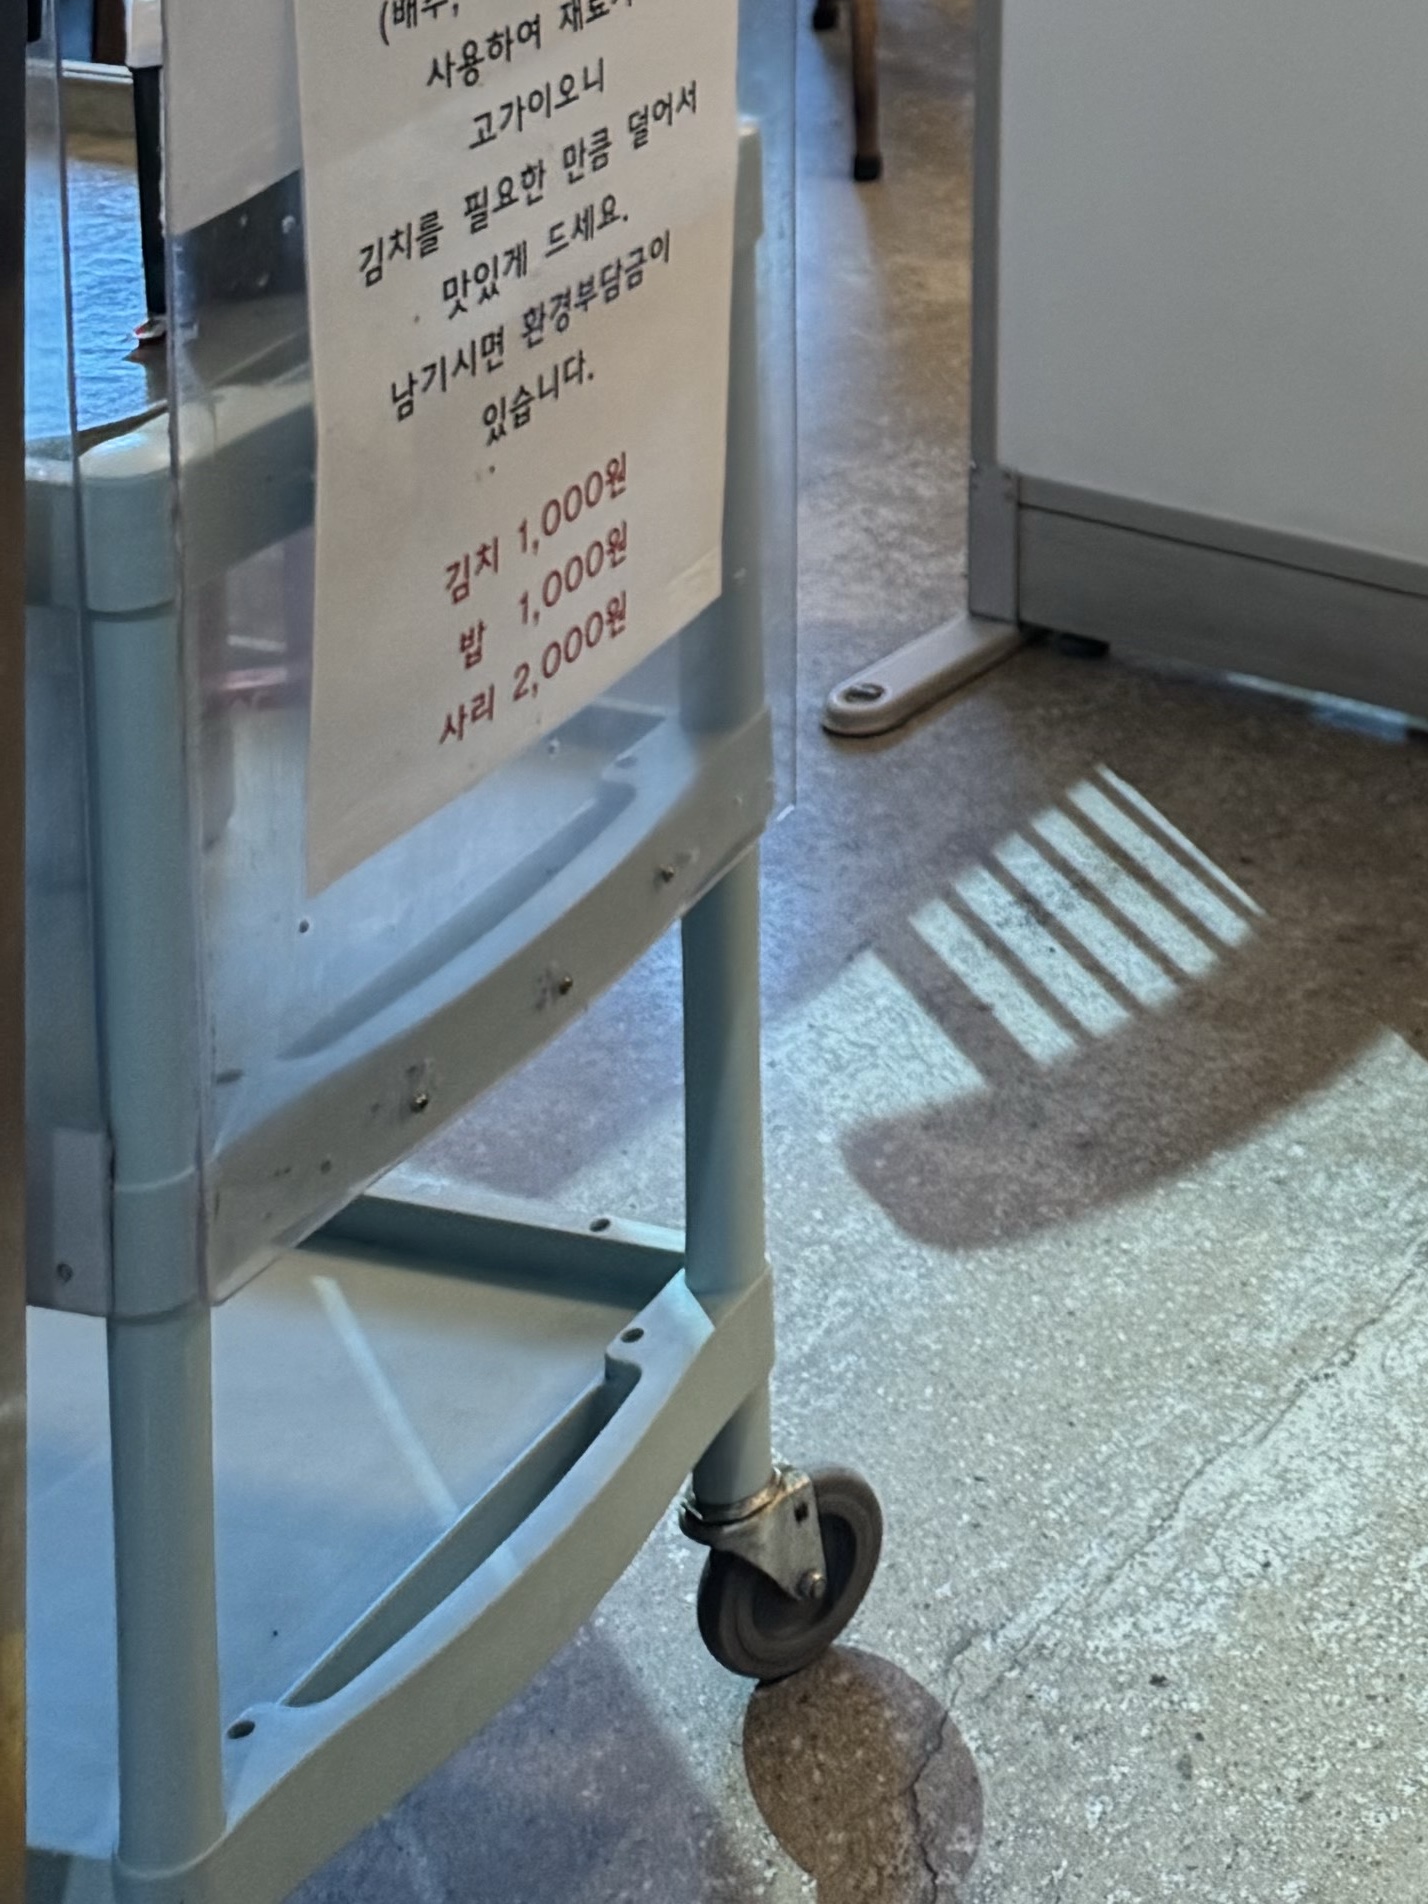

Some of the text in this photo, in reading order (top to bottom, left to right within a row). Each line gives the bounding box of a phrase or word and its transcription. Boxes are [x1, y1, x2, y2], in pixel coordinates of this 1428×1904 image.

[427, 15, 541, 87] 사용하여
[468, 59, 605, 149] 고가이오니
[359, 81, 697, 286] 김치를 필요한 만큼 덜어서
[442, 195, 628, 319] 맛있게 드세요.
[390, 231, 670, 422] 남기시면 환경부담금이
[481, 349, 594, 446] 있습니다.
[445, 452, 627, 605] 김치 1,000원
[459, 522, 627, 670] 밥 1,000원
[439, 591, 627, 744] 사리 2,000원
